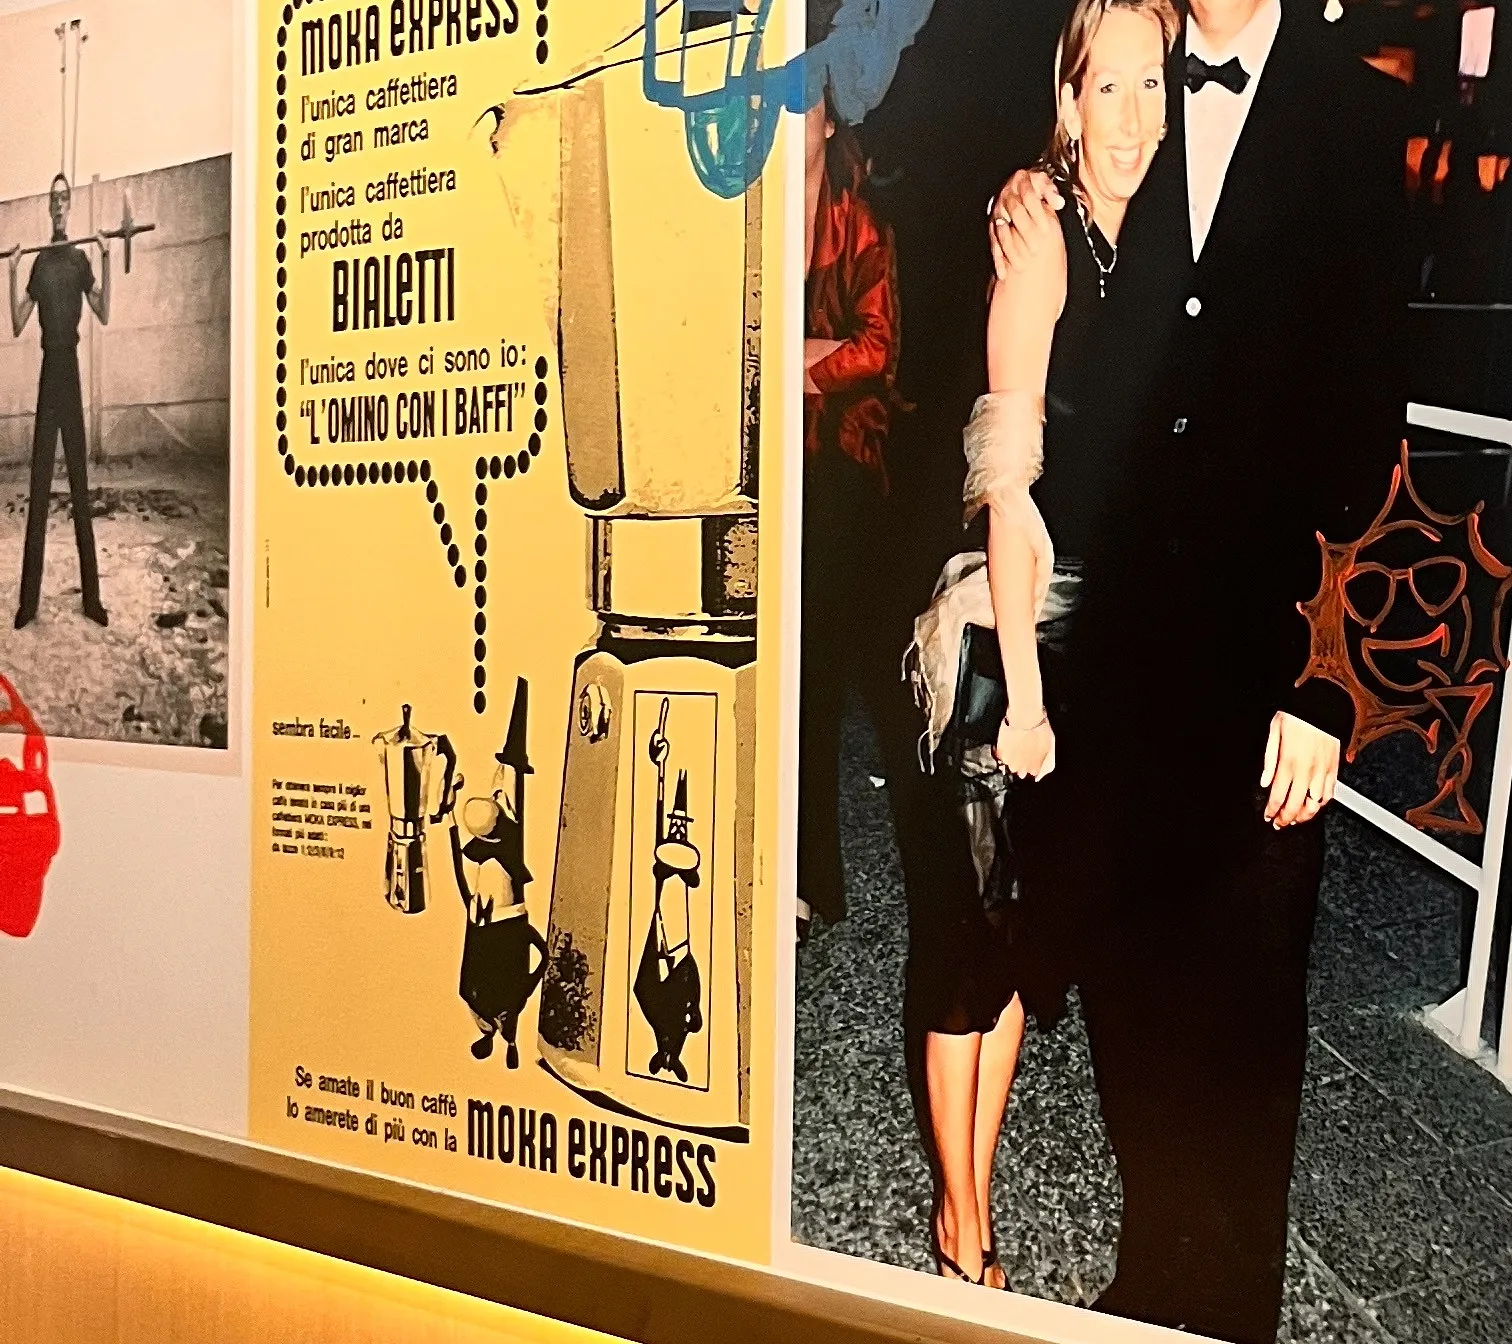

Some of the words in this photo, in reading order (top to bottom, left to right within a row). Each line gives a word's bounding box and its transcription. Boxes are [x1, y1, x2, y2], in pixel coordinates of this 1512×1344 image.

[300, 89, 356, 124] l'unica
[365, 71, 458, 111] caffettiera
[300, 131, 317, 162] di
[324, 128, 364, 164] gran
[373, 118, 430, 150] marca
[300, 180, 356, 215] l'unica
[365, 167, 457, 204] caffettiera
[300, 217, 372, 260] prodotta
[381, 211, 404, 242] da
[300, 355, 356, 387] l'unica
[365, 350, 409, 381] dove
[418, 345, 435, 376] ci
[444, 346, 491, 374] sono
[500, 337, 527, 369] io:
[396, 390, 436, 440] CON
[442, 387, 448, 437] I
[294, 1065, 313, 1089] Se
[318, 1075, 361, 1098] amate
[366, 1079, 375, 1102] il
[380, 1081, 415, 1110] buon
[421, 1092, 458, 1118] caffè
[304, 1105, 359, 1132] amerete
[365, 1112, 378, 1136] di
[384, 1117, 405, 1143] più
[412, 1127, 438, 1149] con
[445, 1127, 458, 1153] la
